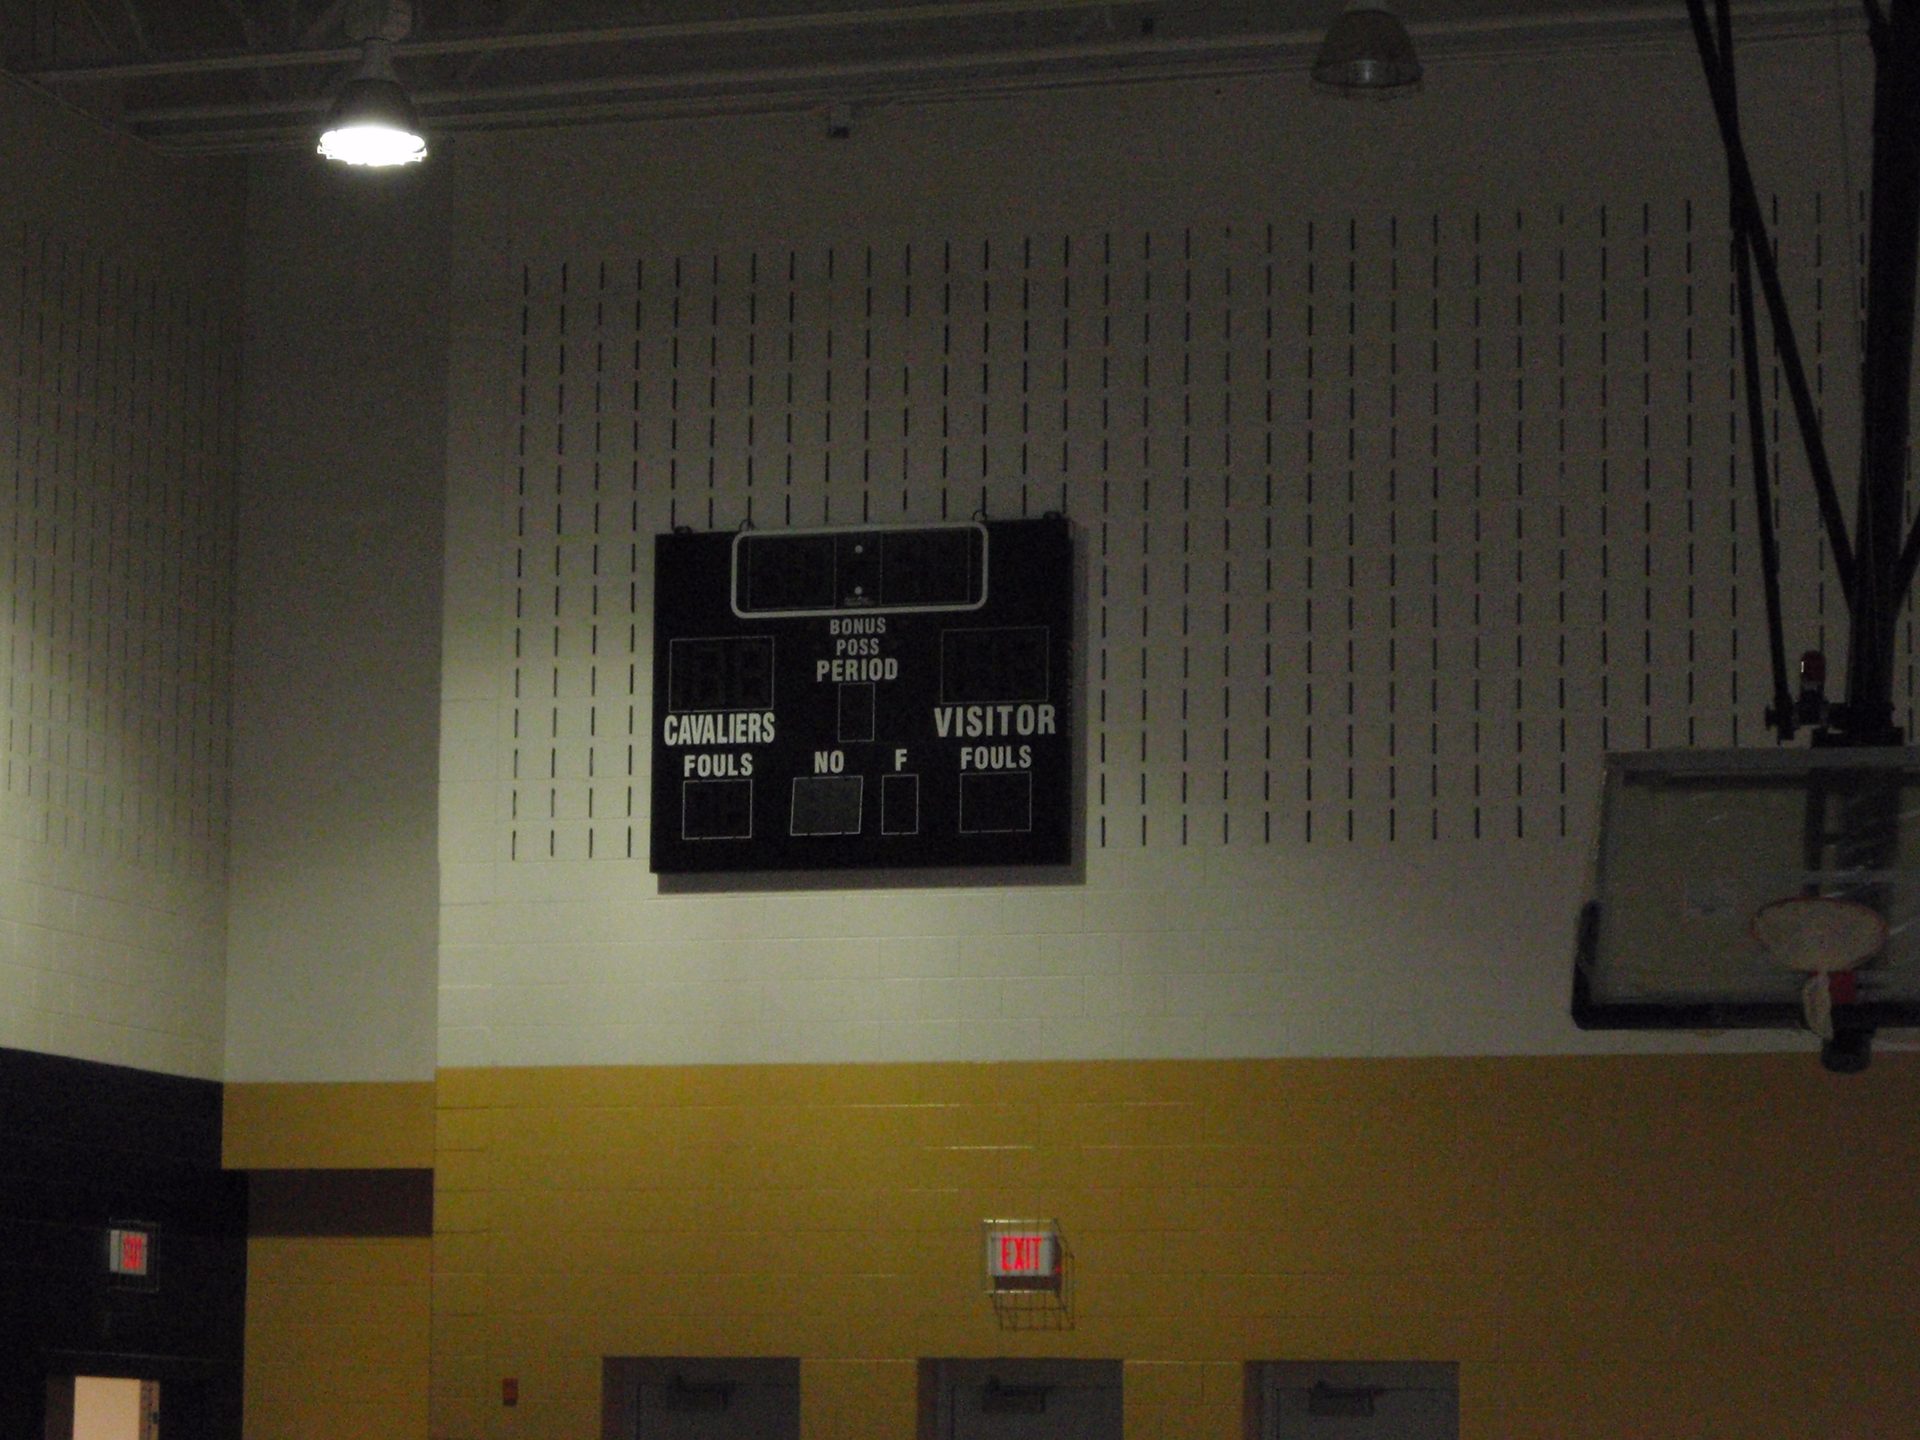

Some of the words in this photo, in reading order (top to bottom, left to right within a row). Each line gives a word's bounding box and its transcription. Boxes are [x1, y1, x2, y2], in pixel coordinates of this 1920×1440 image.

[830, 617, 887, 635] BONUS
[836, 637, 880, 656] POSS
[816, 658, 898, 682] PERIOD
[663, 711, 776, 746] CAVALIERS
[933, 704, 1056, 738] VISITOR
[683, 752, 753, 778] FOULS
[814, 750, 845, 774] NO
[895, 748, 908, 772] F
[960, 744, 1032, 770] FOULS
[1001, 1237, 1042, 1270] EXIT
